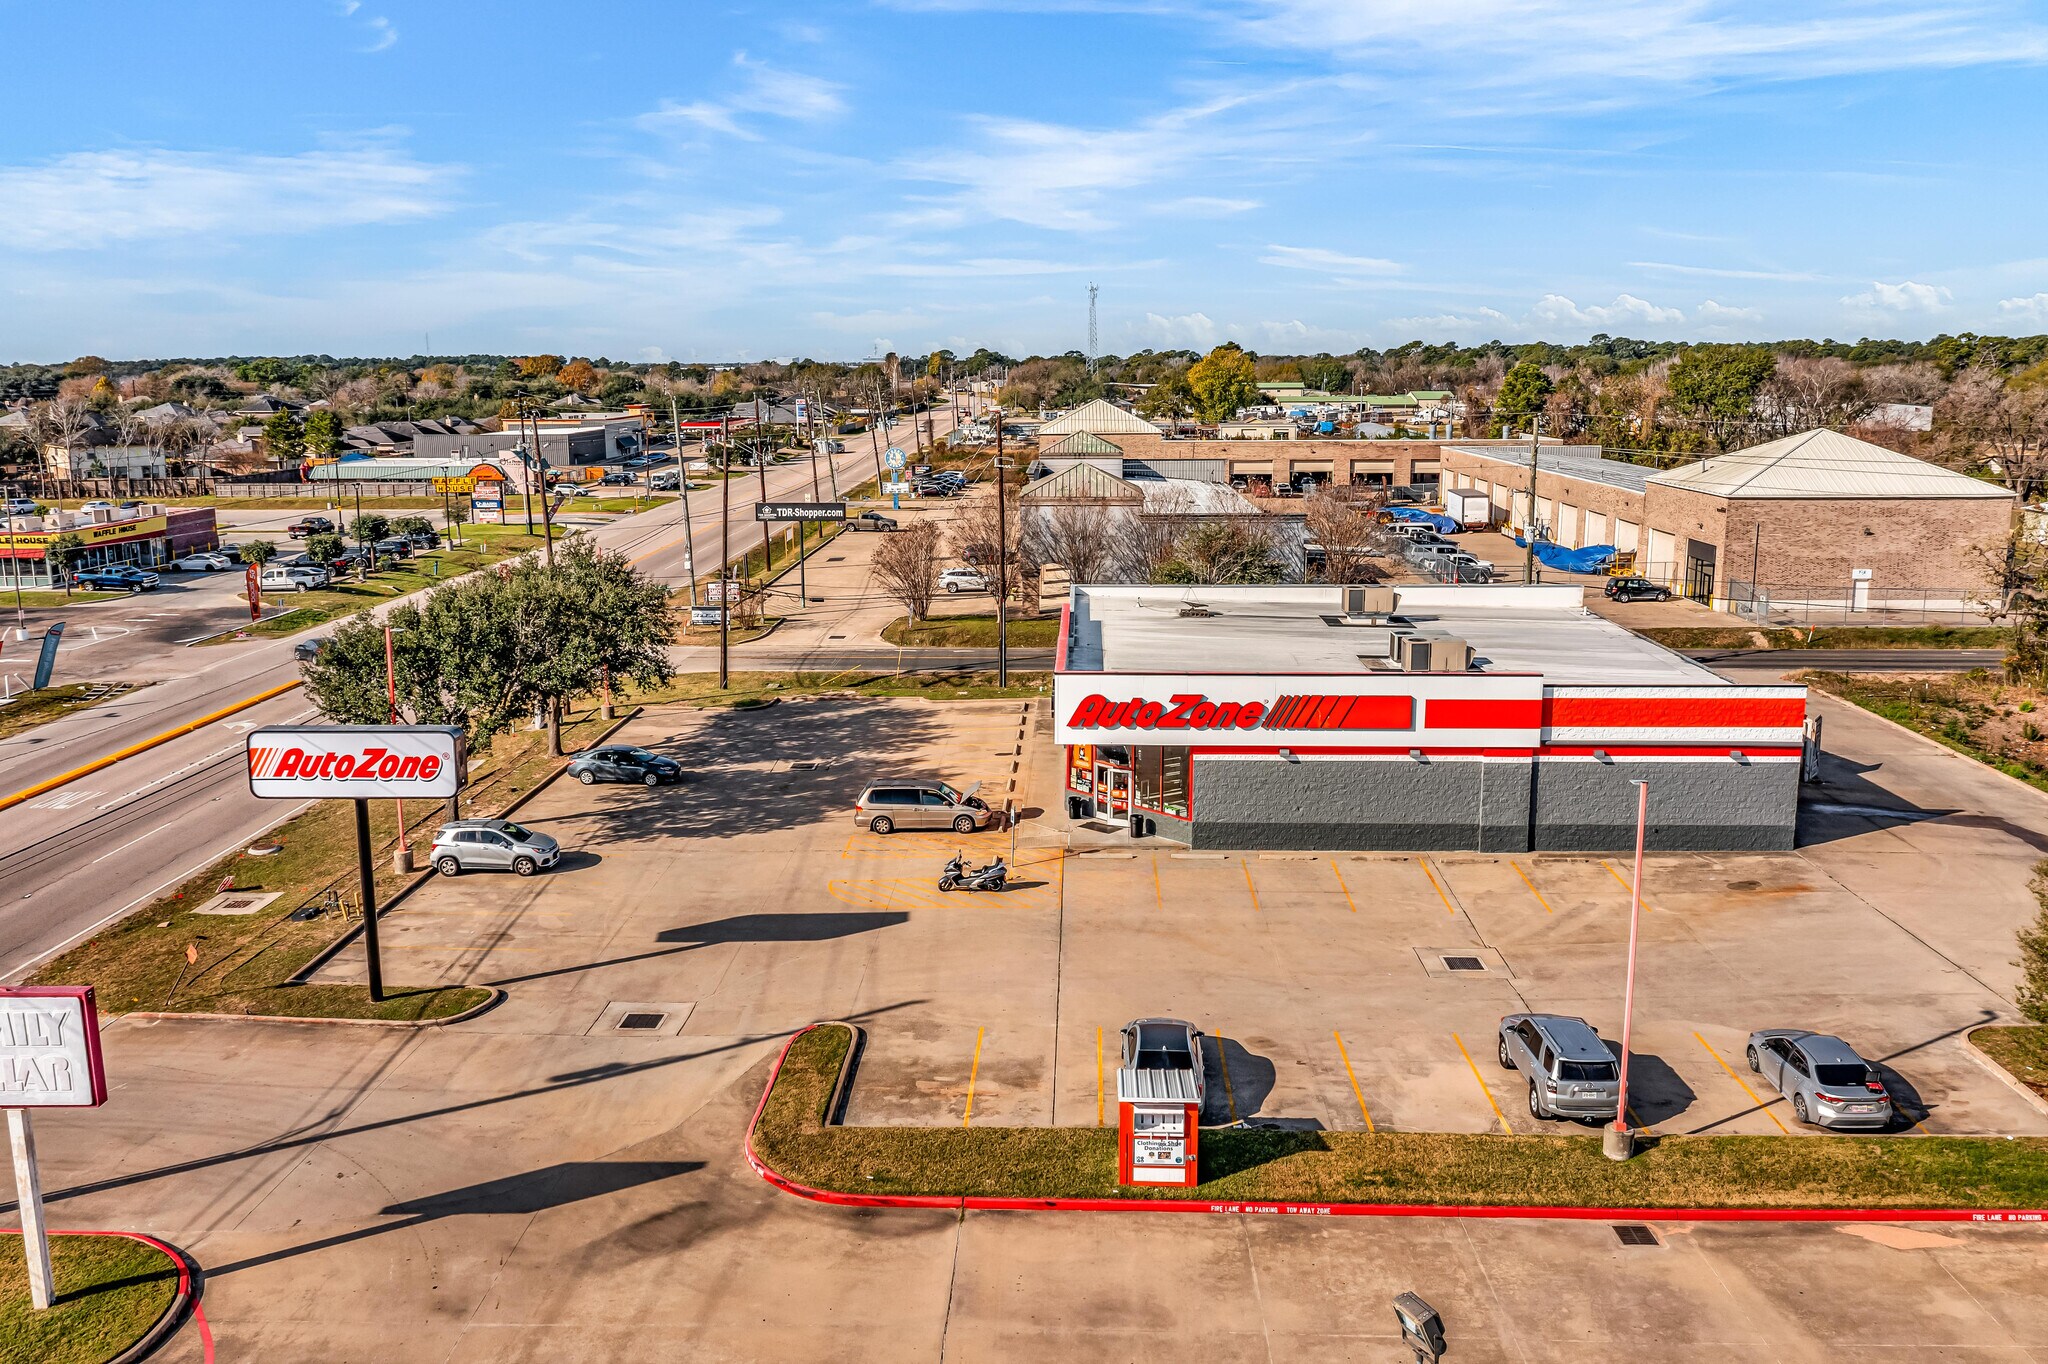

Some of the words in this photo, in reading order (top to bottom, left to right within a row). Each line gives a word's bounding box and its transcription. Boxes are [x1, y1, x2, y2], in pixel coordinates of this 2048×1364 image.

[776, 508, 843, 519] TDR-Shopper.com
[93, 529, 116, 538] WAFFLE
[118, 524, 137, 534] HOUSE
[1066, 694, 1267, 731] AutoZone
[273, 747, 442, 782] AutoZone
[0, 1055, 73, 1093] LAR
[1210, 1205, 1223, 1213] FIRE
[1224, 1205, 1239, 1214] LANE
[1254, 1206, 1279, 1214] PARKING
[1286, 1206, 1297, 1214] TOW
